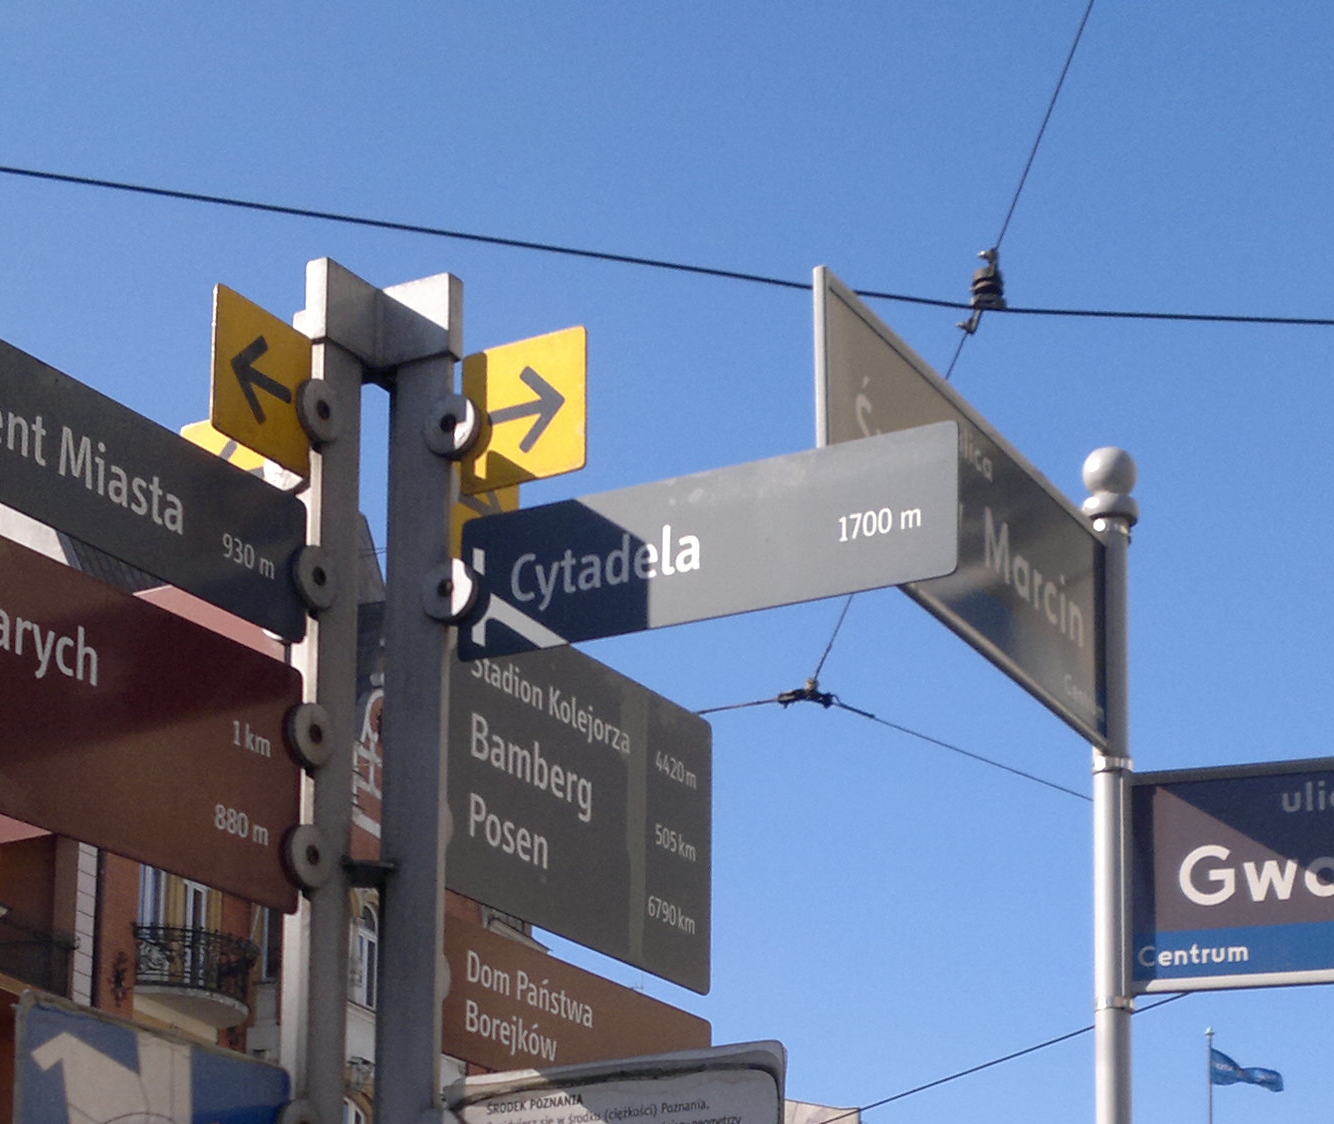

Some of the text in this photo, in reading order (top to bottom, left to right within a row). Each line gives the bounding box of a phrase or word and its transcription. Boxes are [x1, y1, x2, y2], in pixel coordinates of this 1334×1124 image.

[59, 427, 184, 536] Miasta
[221, 532, 276, 580] 930 m
[838, 507, 923, 544] 1700 m
[510, 523, 702, 611] Cytadela
[984, 504, 1084, 648] Marcin
[470, 657, 632, 756] Stadion Kolejorza
[232, 719, 272, 758] 1 km
[470, 713, 594, 823] Bamberg
[214, 803, 269, 846] 880 m
[468, 792, 550, 870] Posen
[1138, 940, 1250, 969] Centrum
[466, 949, 594, 1029] Dom Państwa
[465, 1000, 559, 1062] Borejków
[486, 1093, 585, 1116] ŚRODEK POZNANIA
[604, 1103, 658, 1122] (ciężkości)
[661, 1100, 710, 1115] Poznania.
